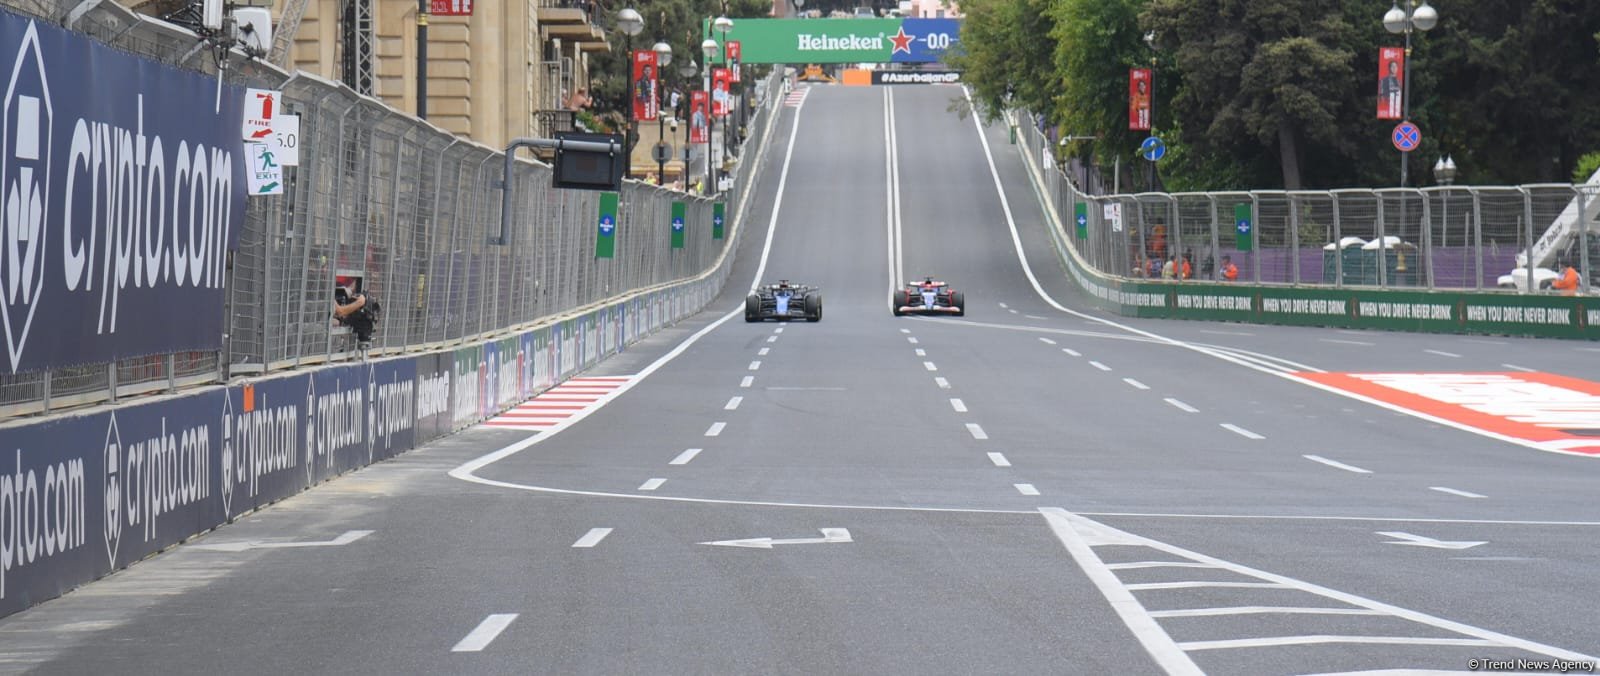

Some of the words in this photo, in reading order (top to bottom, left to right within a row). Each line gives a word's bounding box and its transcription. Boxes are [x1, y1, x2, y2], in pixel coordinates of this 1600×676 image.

[798, 33, 883, 50] Heineken
[927, 33, 949, 49] 0.0
[881, 73, 959, 83] #AzerbaijanGP
[64, 94, 232, 334] crypto.com
[1177, 294, 1192, 308] WHEN
[1192, 295, 1202, 309] YOU
[1203, 295, 1218, 309] DRIVE
[1218, 296, 1235, 310] NEVER
[1235, 296, 1252, 310] DRINK
[1263, 298, 1279, 312] WHEN
[1280, 298, 1292, 313] YOU
[1293, 299, 1309, 313] DRIVE
[1309, 299, 1327, 314] NEVER
[1328, 300, 1346, 315] DRINK
[1359, 302, 1377, 316] WHEN
[1378, 302, 1391, 317] YOU
[1392, 303, 1410, 318] DRIVE
[1411, 303, 1430, 319] NEVER
[1431, 304, 1451, 320] DRINK
[1466, 305, 1486, 321] WHEN
[1488, 305, 1501, 322] YOU
[1503, 306, 1522, 322] DRIVE
[1523, 307, 1546, 323] NEVER
[1547, 308, 1570, 325] DRINK
[317, 378, 363, 469] crypto.com
[236, 393, 297, 497] crypto.com
[127, 416, 210, 542] crypto.com
[0, 448, 86, 599] pto.com
